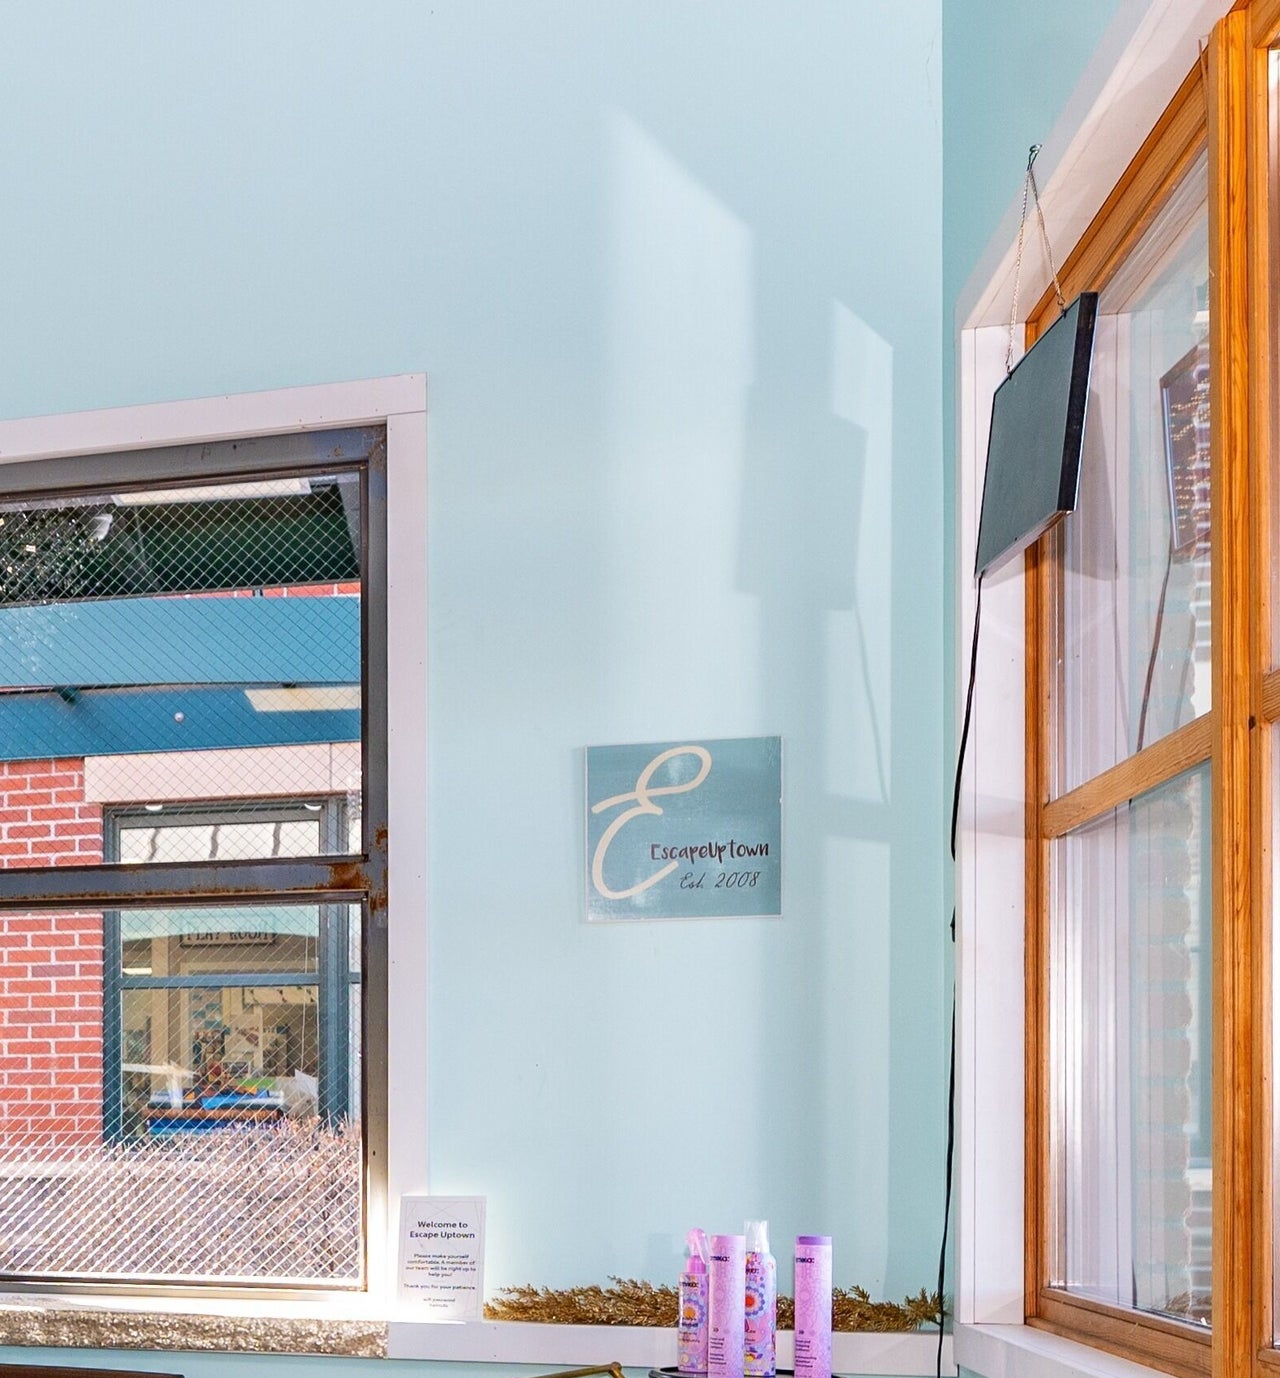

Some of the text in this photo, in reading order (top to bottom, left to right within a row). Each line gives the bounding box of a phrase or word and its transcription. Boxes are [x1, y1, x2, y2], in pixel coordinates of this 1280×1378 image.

[679, 870, 762, 890] Est. 2008
[417, 1220, 457, 1229] Welcome
[410, 1230, 476, 1240] Escape Uptown
